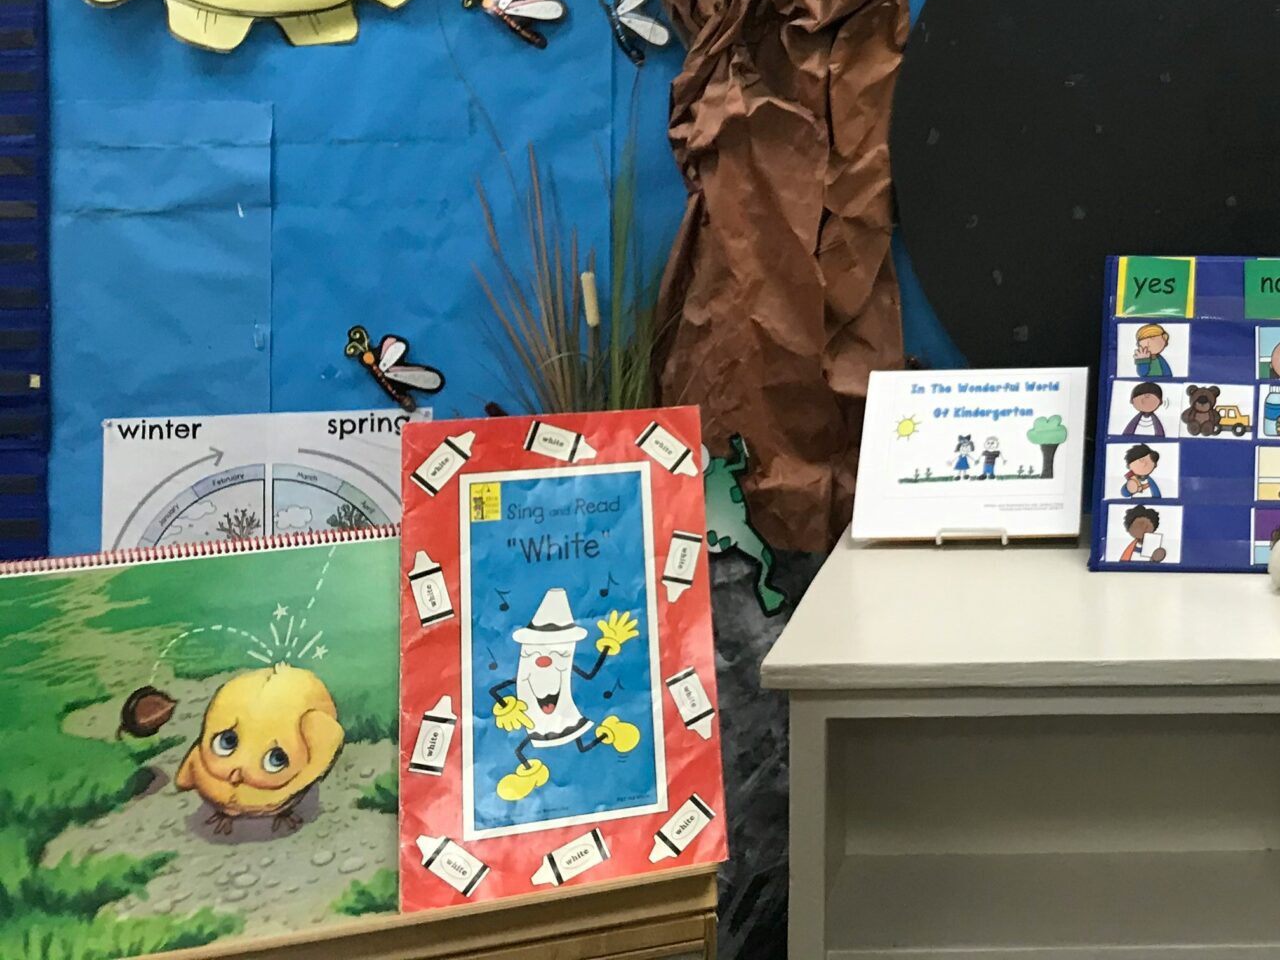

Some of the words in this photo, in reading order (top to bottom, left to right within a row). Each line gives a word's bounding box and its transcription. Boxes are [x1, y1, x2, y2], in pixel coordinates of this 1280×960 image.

[1133, 274, 1175, 298] yes
[911, 384, 925, 394] In
[931, 384, 951, 393] The
[958, 382, 1020, 393] Wonderful
[1025, 381, 1059, 392] World
[953, 407, 1033, 421] Kindergarten
[117, 420, 202, 440] winter
[328, 413, 410, 439] spring
[543, 436, 565, 448] white
[654, 438, 674, 457] white
[430, 455, 450, 477] white
[507, 504, 544, 524] Sing
[550, 505, 570, 516] and
[575, 496, 620, 514] Read
[507, 530, 610, 563] "White"
[678, 545, 687, 570] white
[684, 685, 697, 709] white
[426, 730, 438, 756] white
[675, 813, 696, 835] white
[564, 846, 591, 865] white
[446, 856, 467, 878] white
